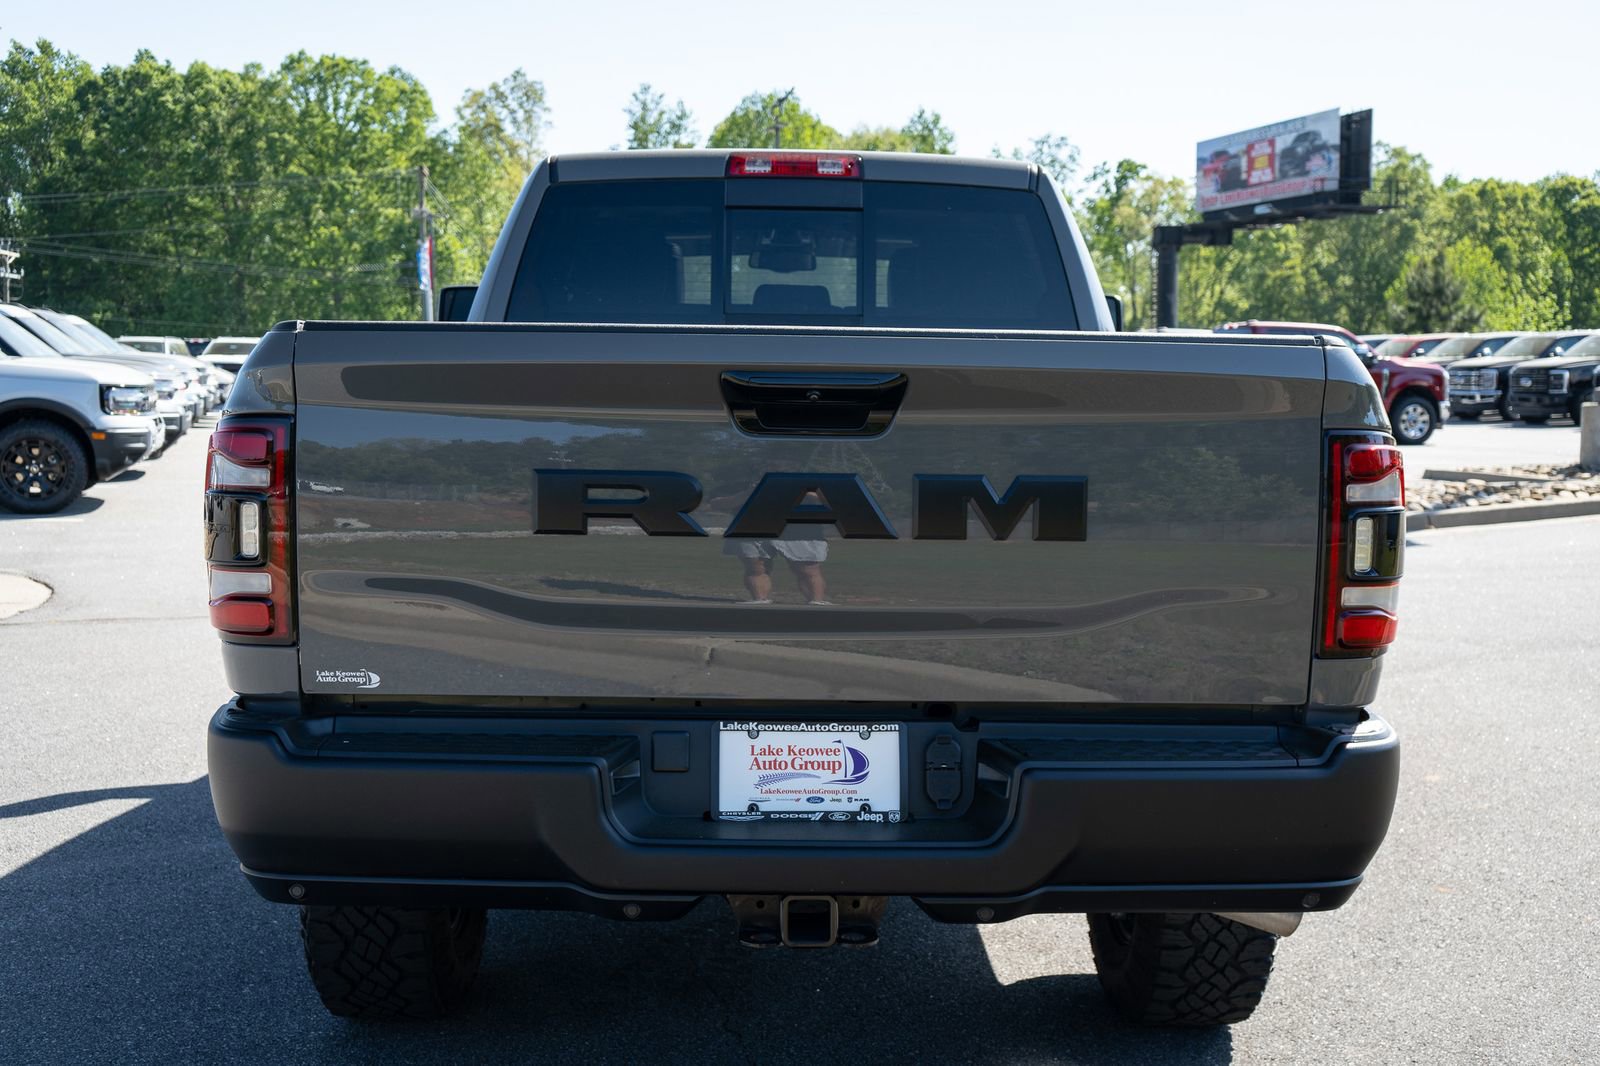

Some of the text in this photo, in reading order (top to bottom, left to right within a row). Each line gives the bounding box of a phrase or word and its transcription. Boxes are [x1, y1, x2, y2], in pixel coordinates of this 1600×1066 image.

[533, 468, 1089, 541] RAM
[719, 721, 899, 733] LakeKeoweeAutoGroup.com
[750, 744, 841, 757] Lake Keowee
[748, 757, 842, 774] Auto Group
[760, 788, 858, 796] LakeKeoweeAutoGroup.Com
[857, 811, 884, 822] Jeep
